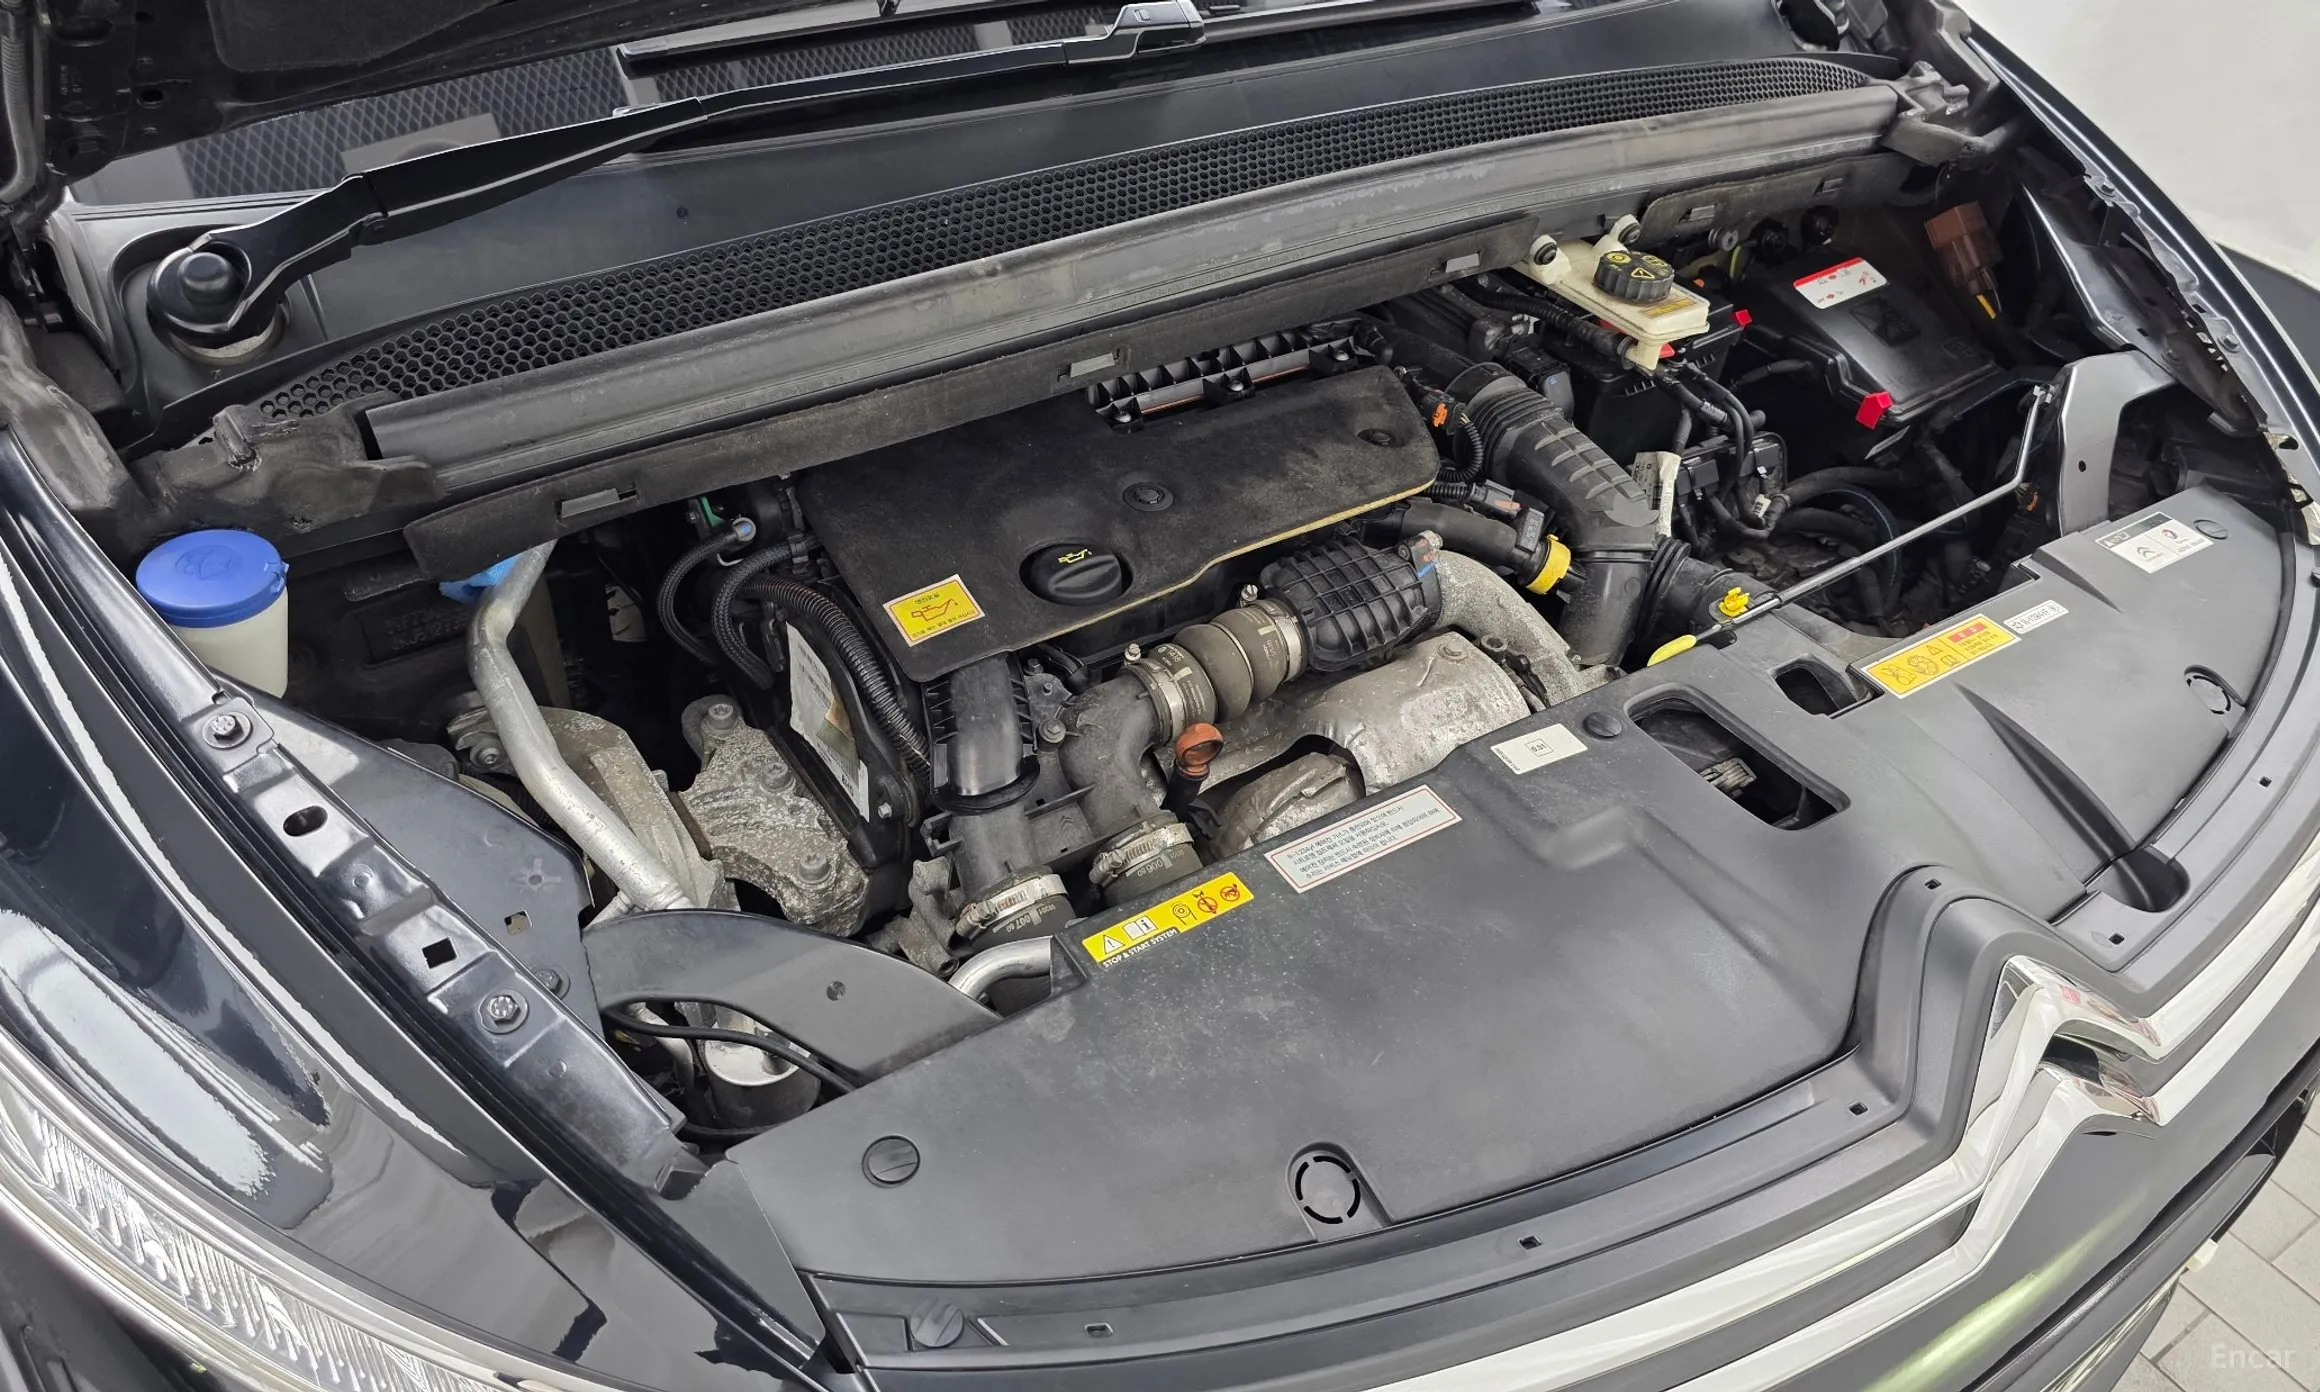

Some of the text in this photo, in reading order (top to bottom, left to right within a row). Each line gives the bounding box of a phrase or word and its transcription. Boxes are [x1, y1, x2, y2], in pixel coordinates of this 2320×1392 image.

[1103, 954, 1122, 968] STOP
[1130, 940, 1151, 956] START
[1151, 928, 1178, 948] SYSTEM
